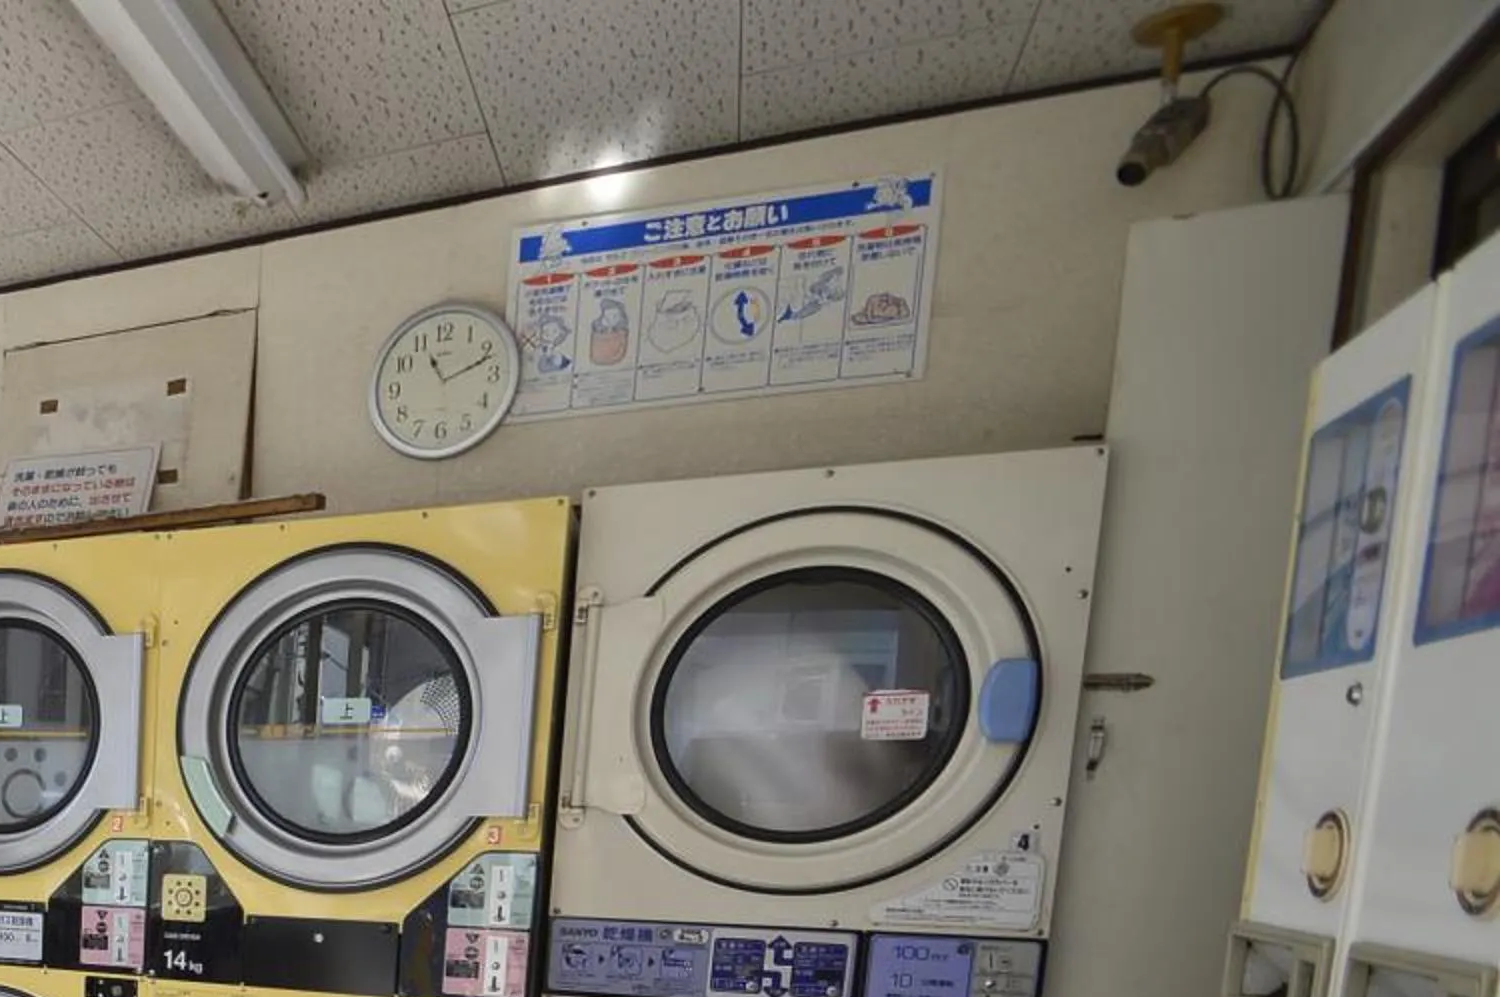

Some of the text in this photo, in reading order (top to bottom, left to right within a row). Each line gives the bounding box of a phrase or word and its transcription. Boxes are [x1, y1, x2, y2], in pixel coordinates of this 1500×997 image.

[644, 204, 789, 241] ご注意とお願い
[436, 323, 454, 343] 12
[467, 325, 474, 344] 1
[414, 334, 427, 353] 11
[396, 354, 413, 374] 10
[487, 365, 501, 383] 3
[388, 383, 401, 400] 9
[477, 393, 488, 409] 4
[396, 405, 408, 423] 8
[459, 414, 472, 431] 5
[413, 419, 426, 438] 7
[434, 421, 447, 439] 6
[338, 702, 355, 720] 上
[1017, 834, 1030, 851] 4
